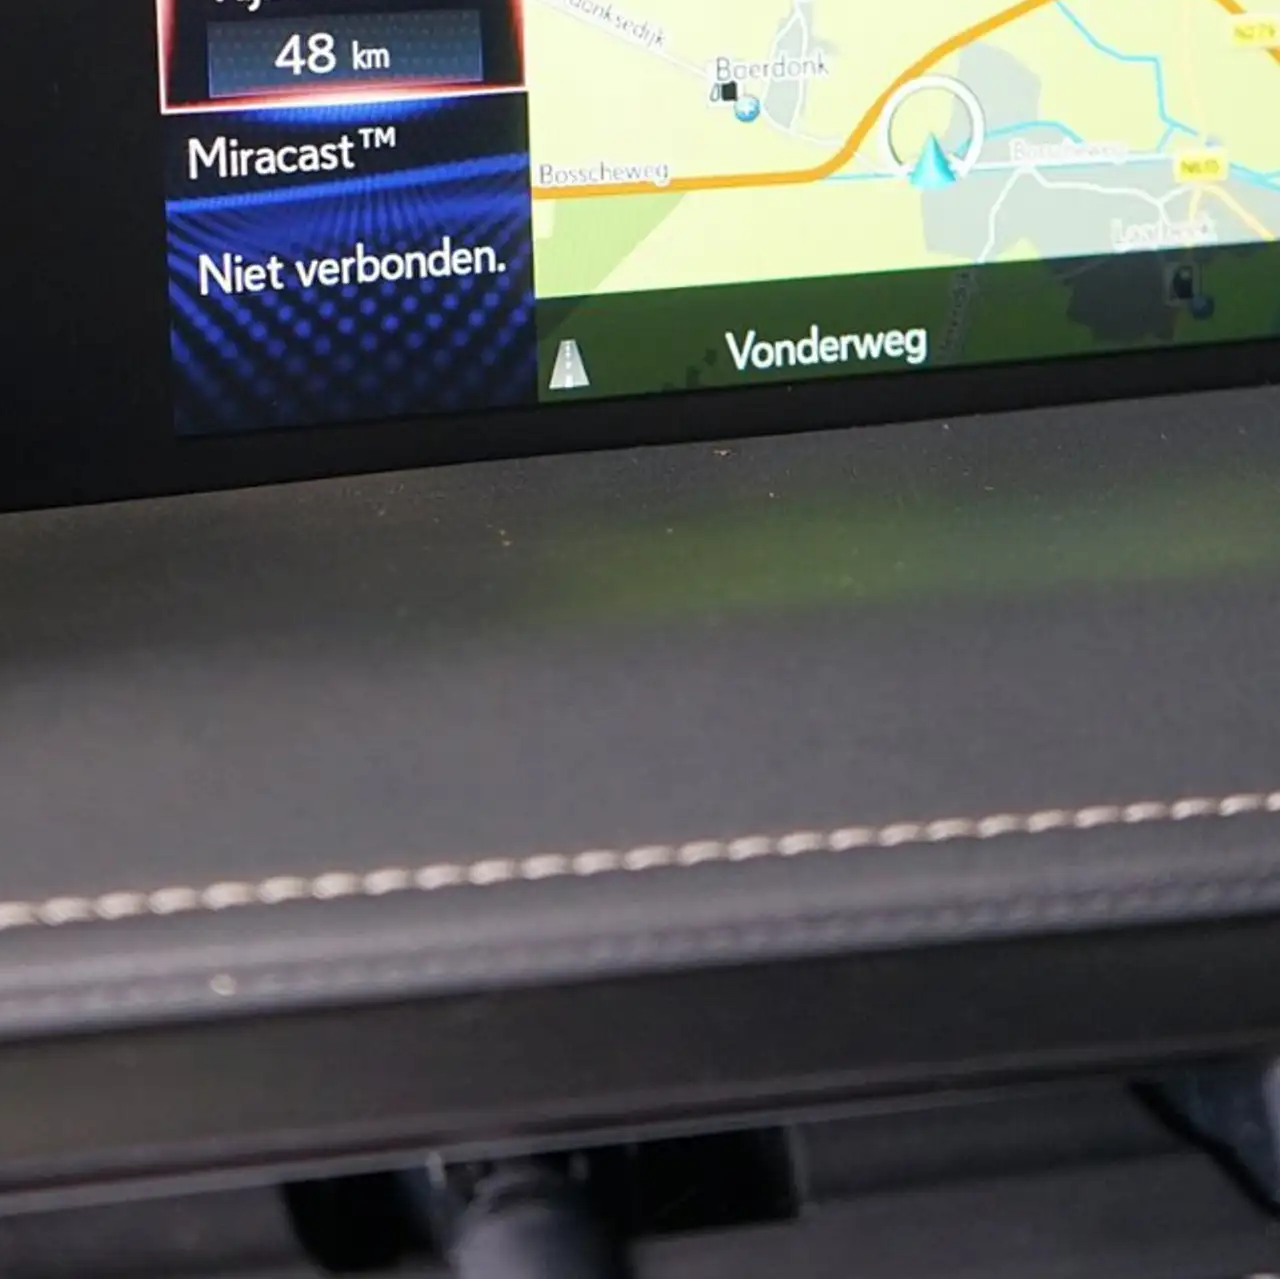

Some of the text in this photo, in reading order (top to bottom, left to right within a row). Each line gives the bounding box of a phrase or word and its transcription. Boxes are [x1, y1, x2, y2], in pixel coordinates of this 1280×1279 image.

[275, 32, 390, 75] 48 km
[716, 52, 829, 82] Boerdonk
[538, 161, 669, 186] Bosscheweg
[199, 236, 506, 296] Niet verbonden.
[724, 324, 928, 370] Vonderweg
